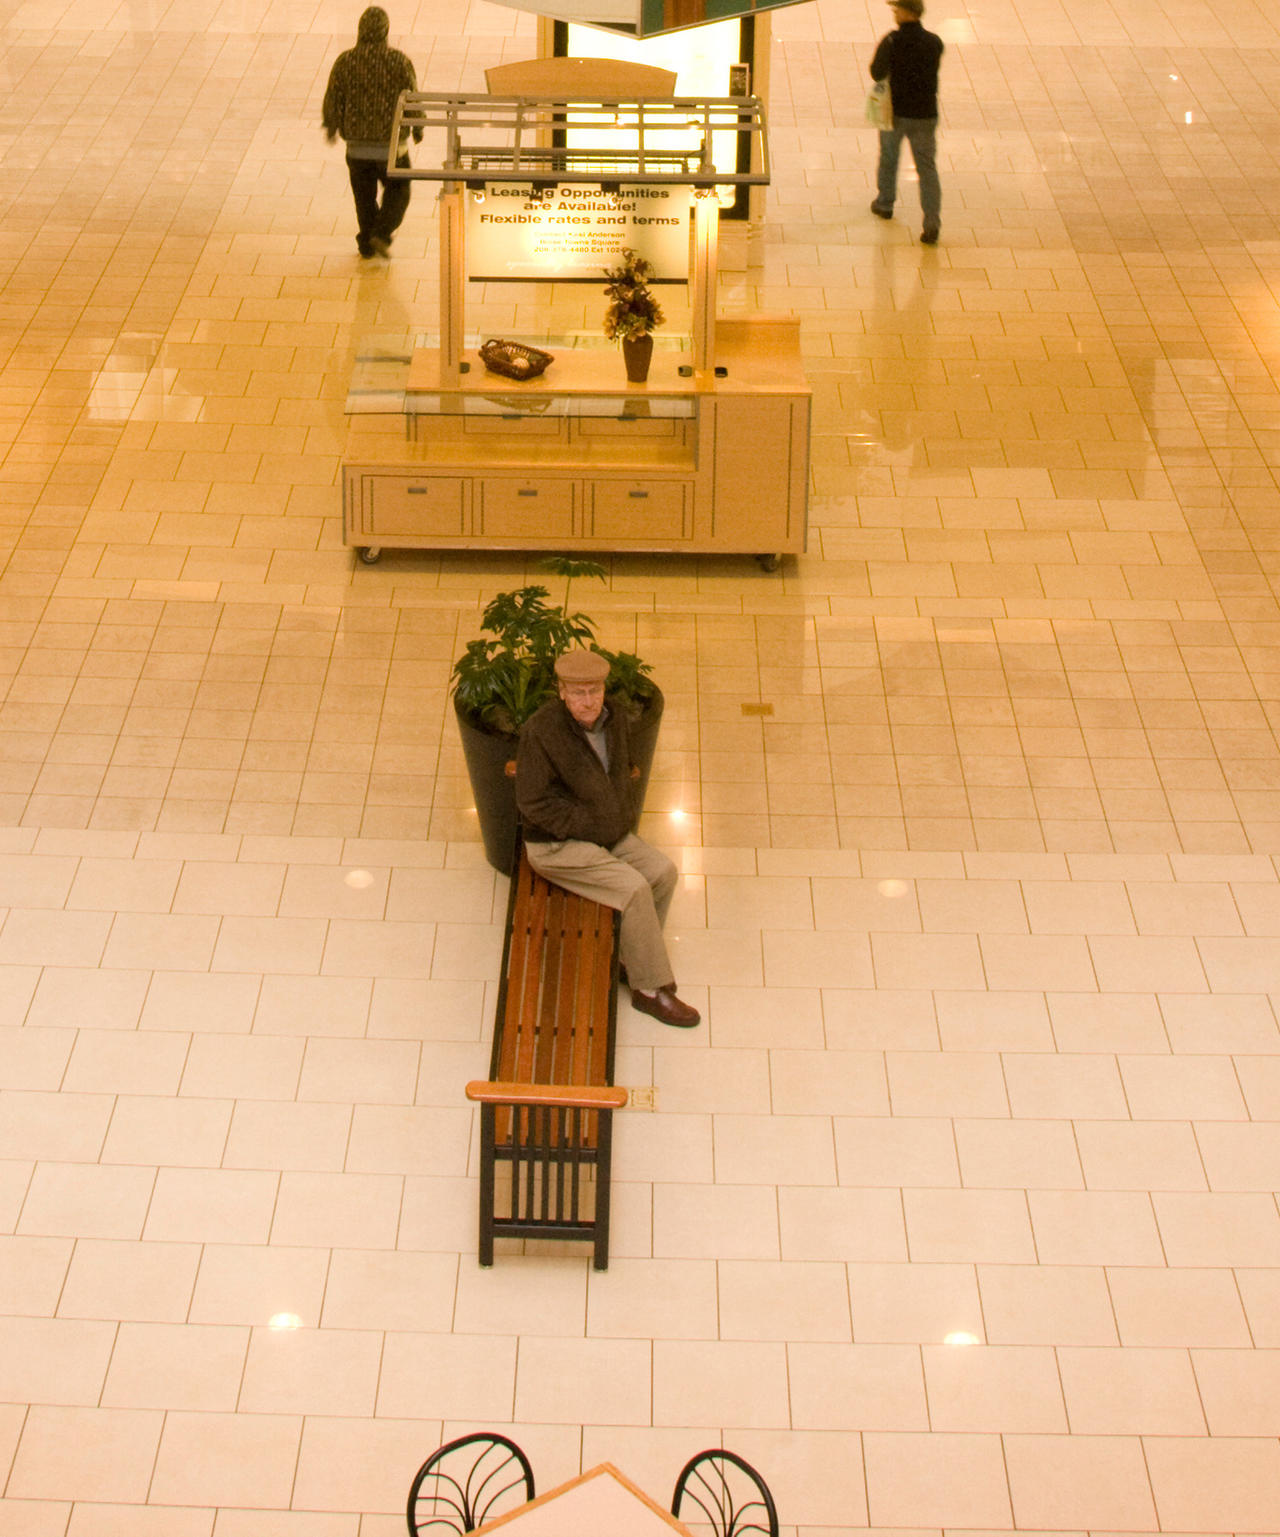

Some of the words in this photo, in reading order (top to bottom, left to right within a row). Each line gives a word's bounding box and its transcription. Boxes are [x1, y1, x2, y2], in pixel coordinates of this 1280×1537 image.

[480, 214, 542, 225] Flexible
[548, 215, 591, 225] rates
[596, 215, 626, 225] and
[632, 215, 680, 226] terms
[587, 231, 626, 239] Anderson
